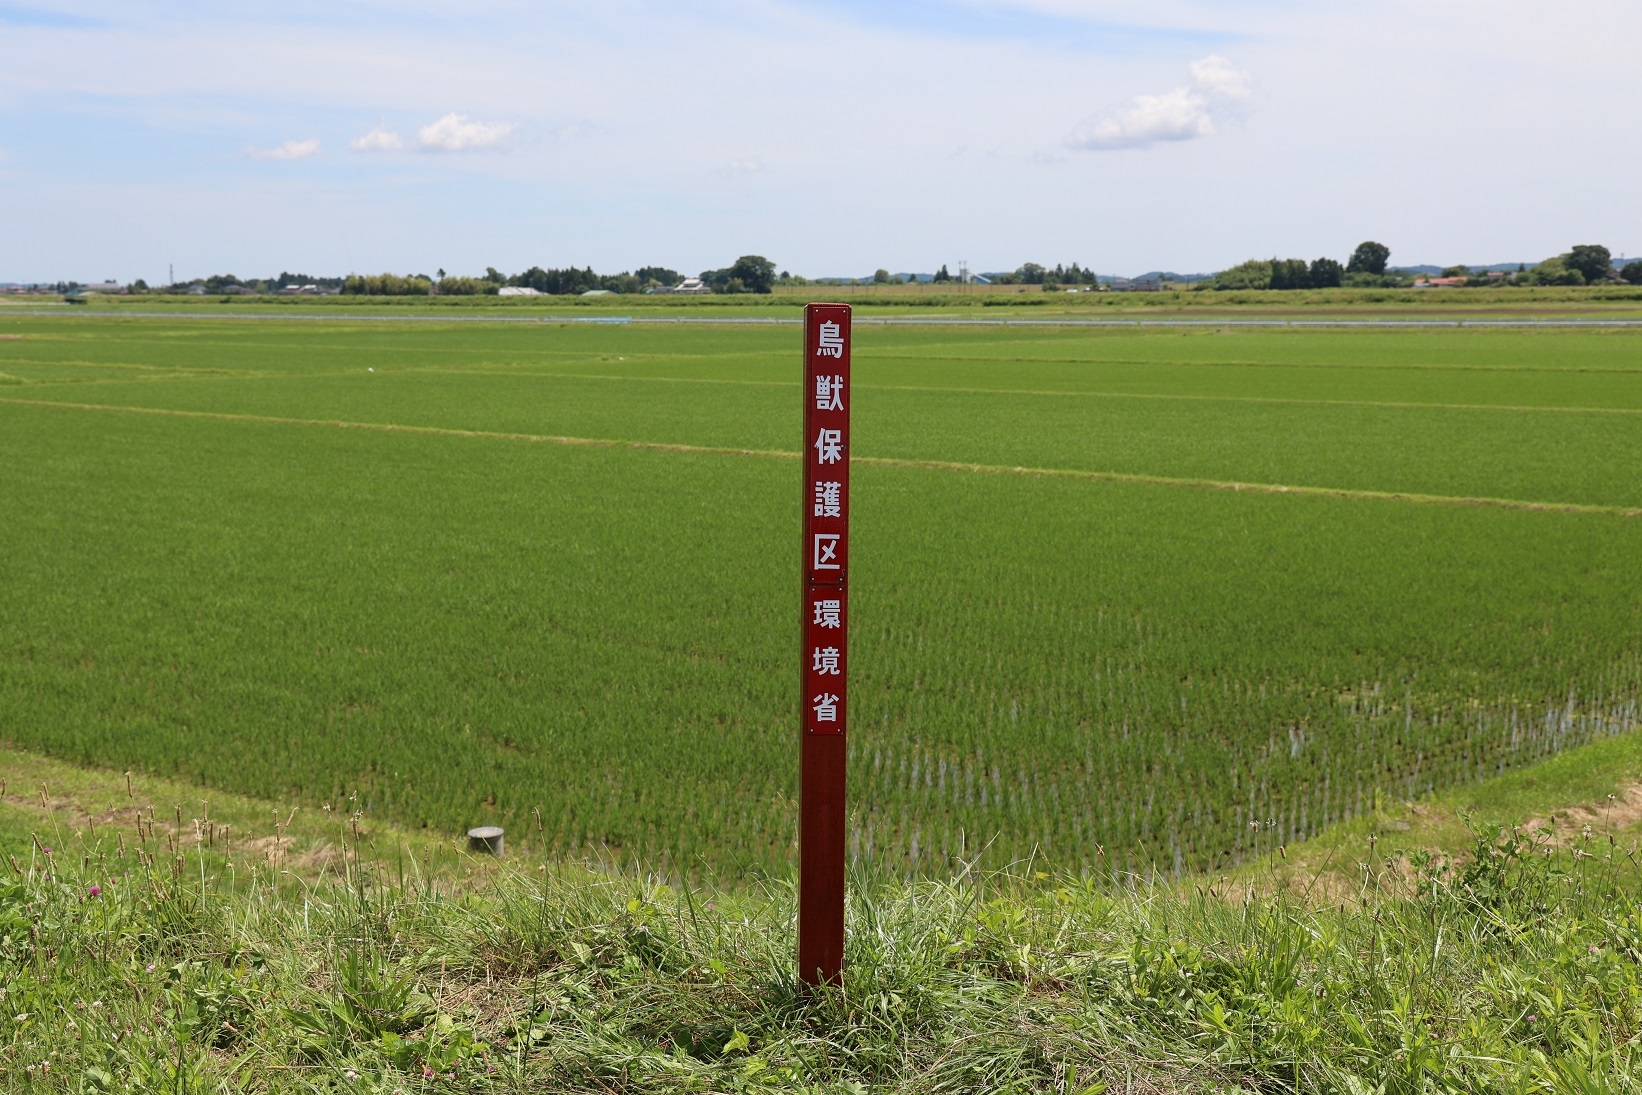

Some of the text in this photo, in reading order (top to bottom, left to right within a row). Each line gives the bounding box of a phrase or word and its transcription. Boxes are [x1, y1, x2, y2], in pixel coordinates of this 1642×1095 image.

[814, 320, 844, 570] 鳥獣保護区
[813, 599, 841, 722] 環境省
